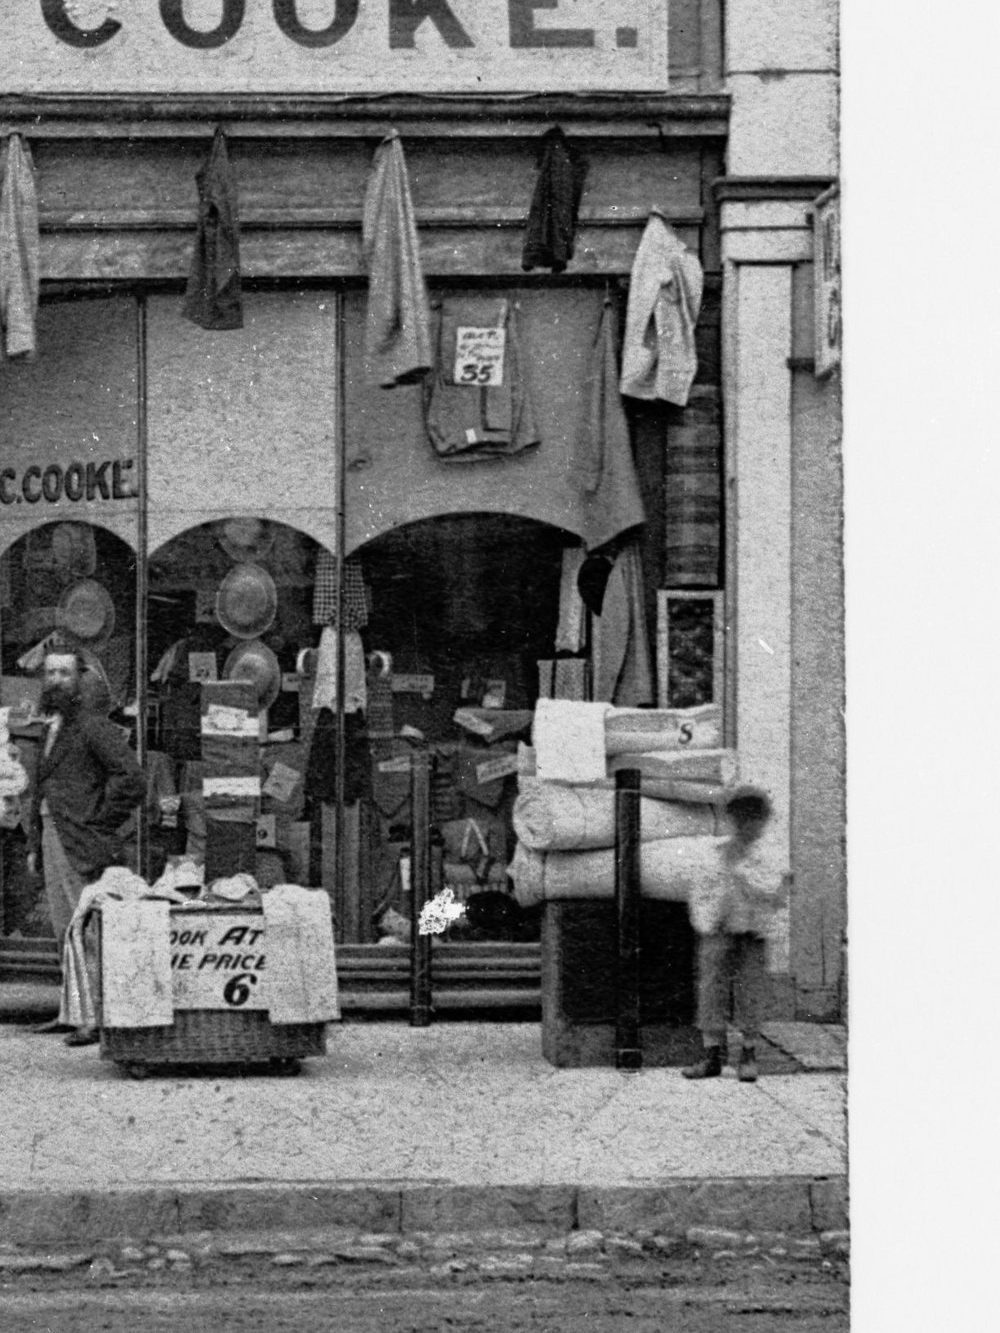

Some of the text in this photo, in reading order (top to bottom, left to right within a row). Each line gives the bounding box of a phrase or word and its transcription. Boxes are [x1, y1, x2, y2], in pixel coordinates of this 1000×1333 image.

[169, 926, 264, 947] OOK AT
[198, 953, 267, 971] PRICE
[223, 972, 258, 1007] 6
